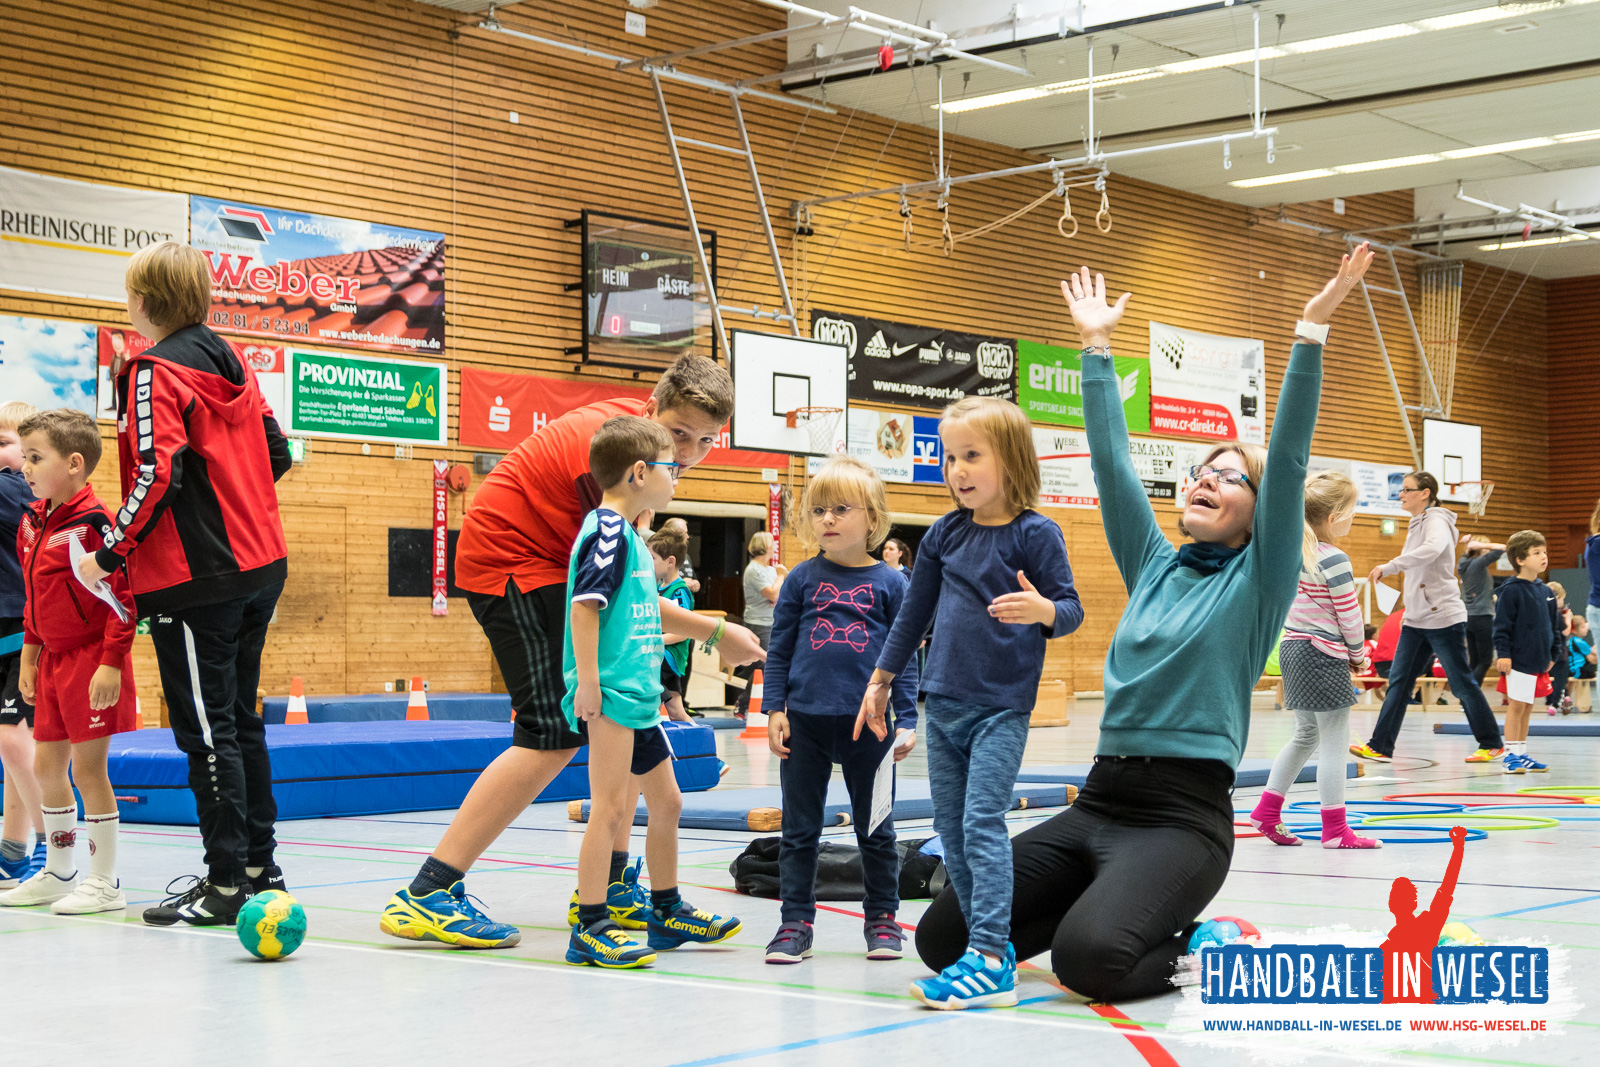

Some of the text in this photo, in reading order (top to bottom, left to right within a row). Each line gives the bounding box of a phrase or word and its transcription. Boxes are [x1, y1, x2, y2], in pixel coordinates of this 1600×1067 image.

[1, 209, 117, 247] RHEINISCHE
[278, 216, 293, 231] Ihr
[203, 250, 360, 303] Weber
[602, 268, 629, 287] HEIM
[657, 274, 690, 296] GÄSTE
[211, 289, 267, 303] edachungen
[330, 302, 357, 314] GmbH
[213, 310, 309, 335] 02 81 / 5 23 94
[611, 316, 620, 334] 0
[318, 328, 440, 349] www.weberbedachungen.de
[864, 347, 891, 358] adidas
[299, 361, 405, 391] PROVINZIAL
[983, 367, 1008, 379] SPORT
[1029, 361, 1082, 395] erim
[299, 384, 406, 403] Die Versicherung der Sparkassen
[873, 380, 965, 399] www.ropa-sport.de
[338, 402, 369, 413] Egerlandt
[371, 406, 383, 415] und
[384, 406, 405, 416] Söhne
[1029, 400, 1067, 415] SPORTSWEAR
[1154, 416, 1228, 436] www.cr-direkt.de
[1054, 437, 1079, 451] WESEL
[436, 490, 445, 575] HSG WESEL
[772, 510, 780, 536] HSG
[664, 917, 707, 936] Kempa
[578, 929, 612, 955] Kempa
